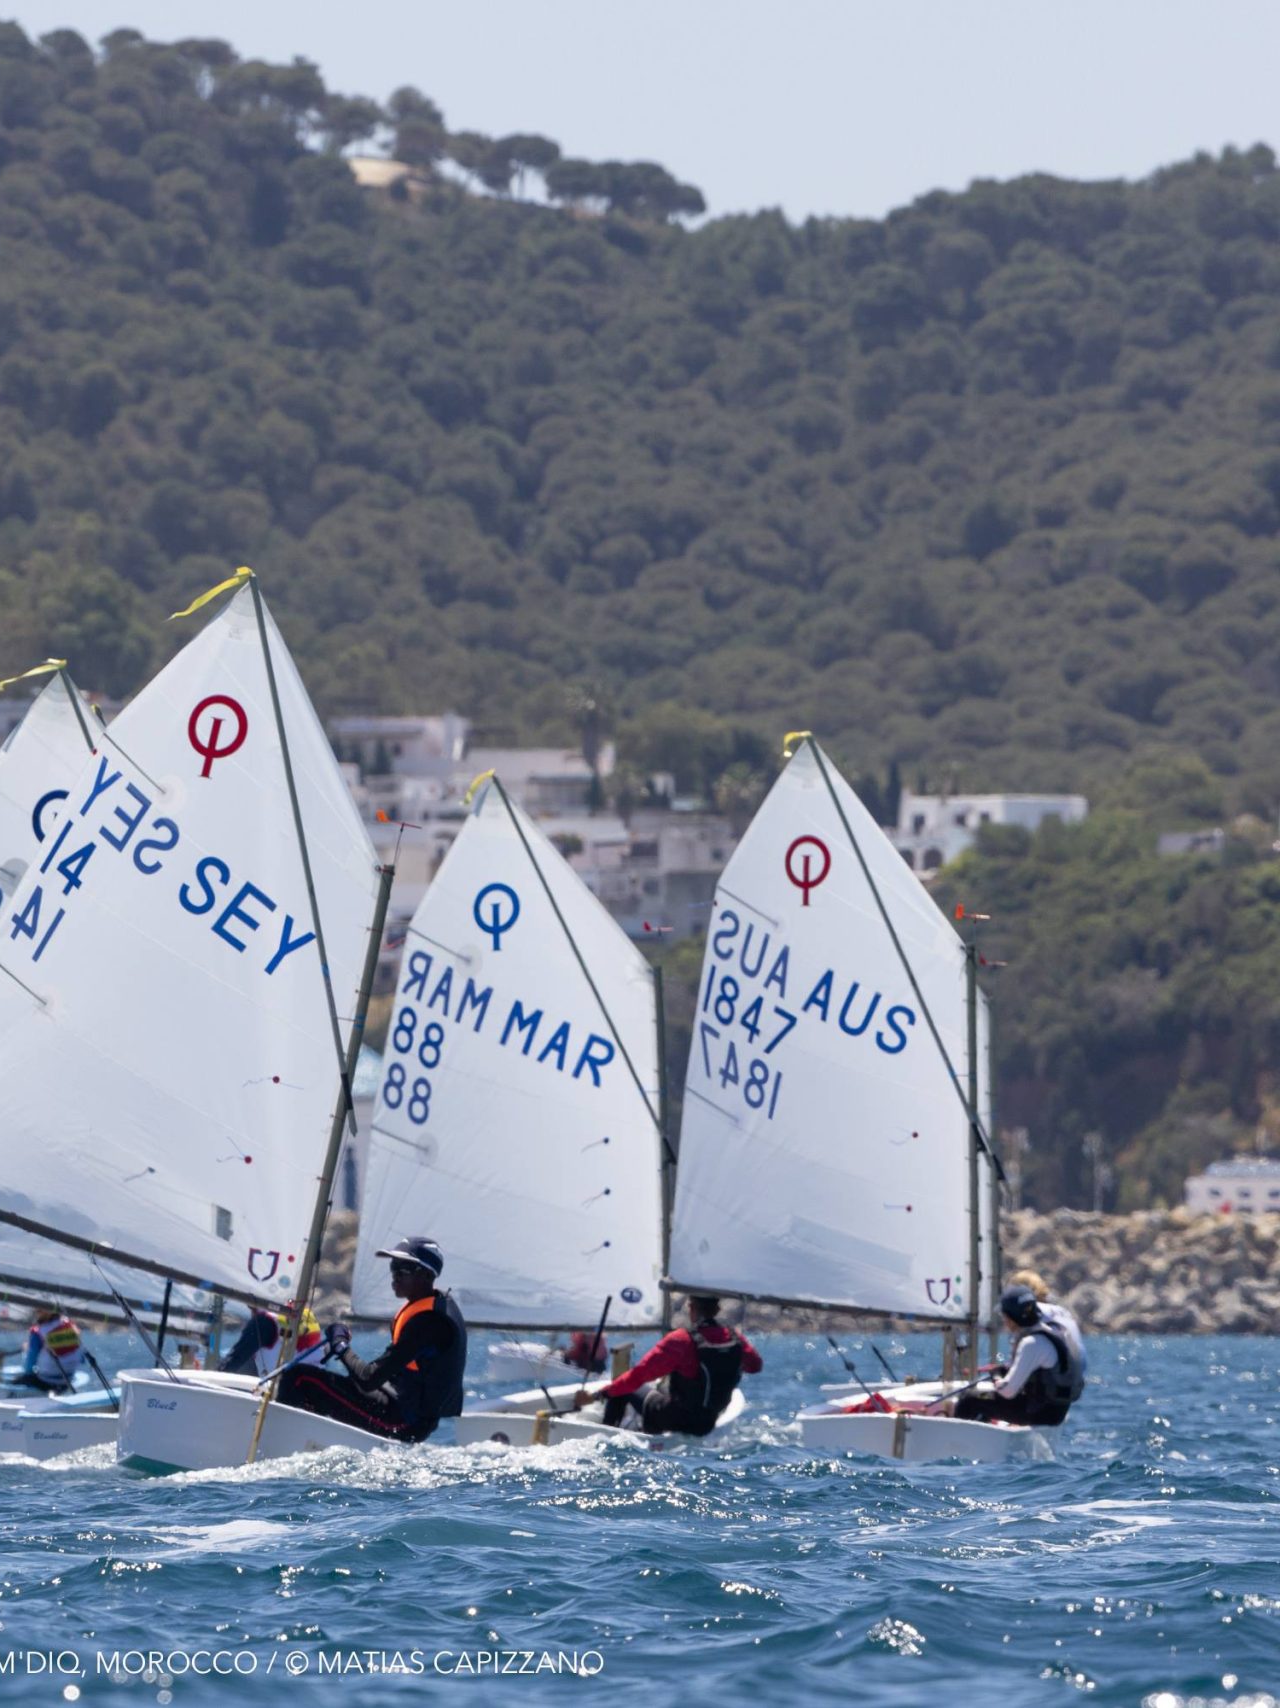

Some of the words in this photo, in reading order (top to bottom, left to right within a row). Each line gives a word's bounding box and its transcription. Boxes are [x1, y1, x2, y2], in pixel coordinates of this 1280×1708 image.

[40, 820, 97, 895] 14
[179, 857, 317, 975] SEY
[393, 1006, 445, 1069] 88
[499, 1000, 616, 1089] MAR
[703, 965, 797, 1054] 1847
[801, 968, 916, 1055] AUS
